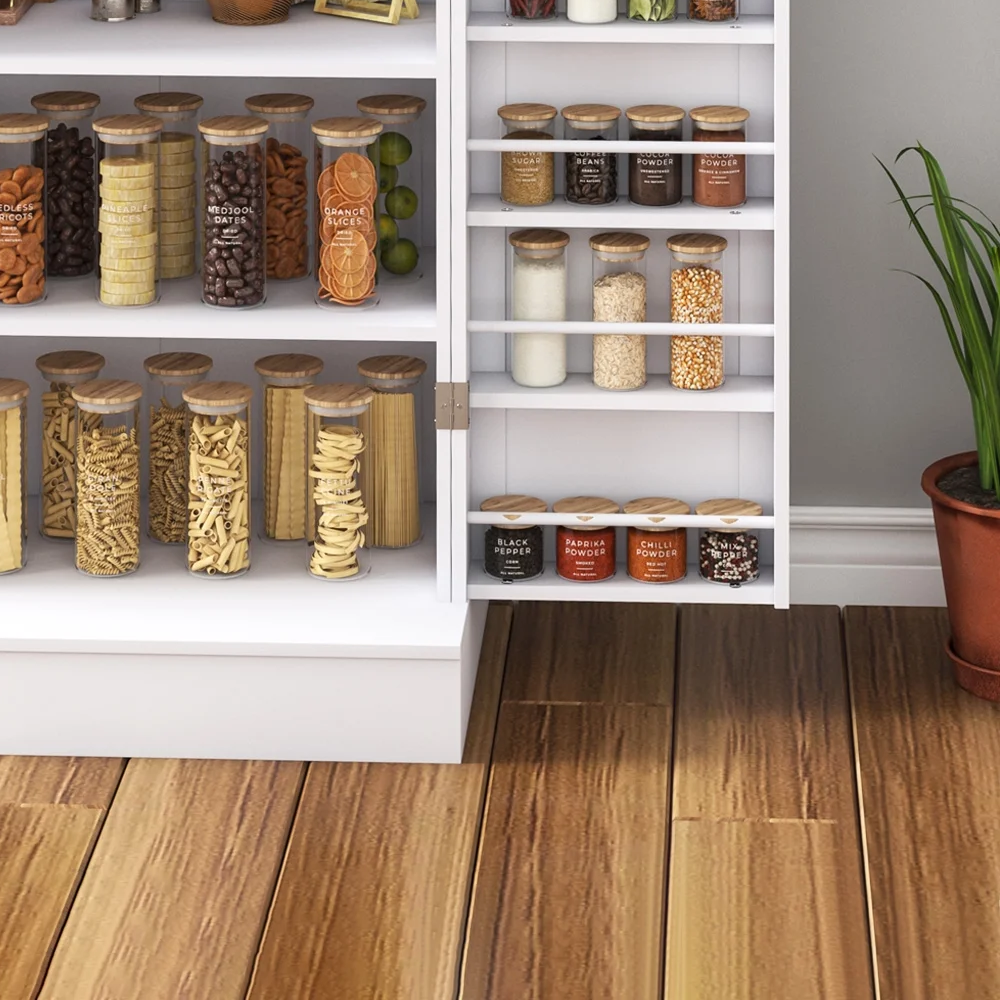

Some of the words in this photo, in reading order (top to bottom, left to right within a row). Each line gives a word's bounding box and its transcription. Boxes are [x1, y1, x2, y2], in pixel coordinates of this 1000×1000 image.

[637, 158, 673, 166] POWDER
[208, 205, 254, 215] MEDJOOL
[324, 207, 365, 216] ORANGE
[214, 216, 246, 224] DATES
[497, 538, 528, 546] BLACK
[565, 539, 606, 547] PAPRIKA
[494, 547, 531, 555] PEPPER
[565, 548, 606, 557] POWDER
[636, 550, 677, 558] POWDER
[711, 551, 748, 559] PEPPER
